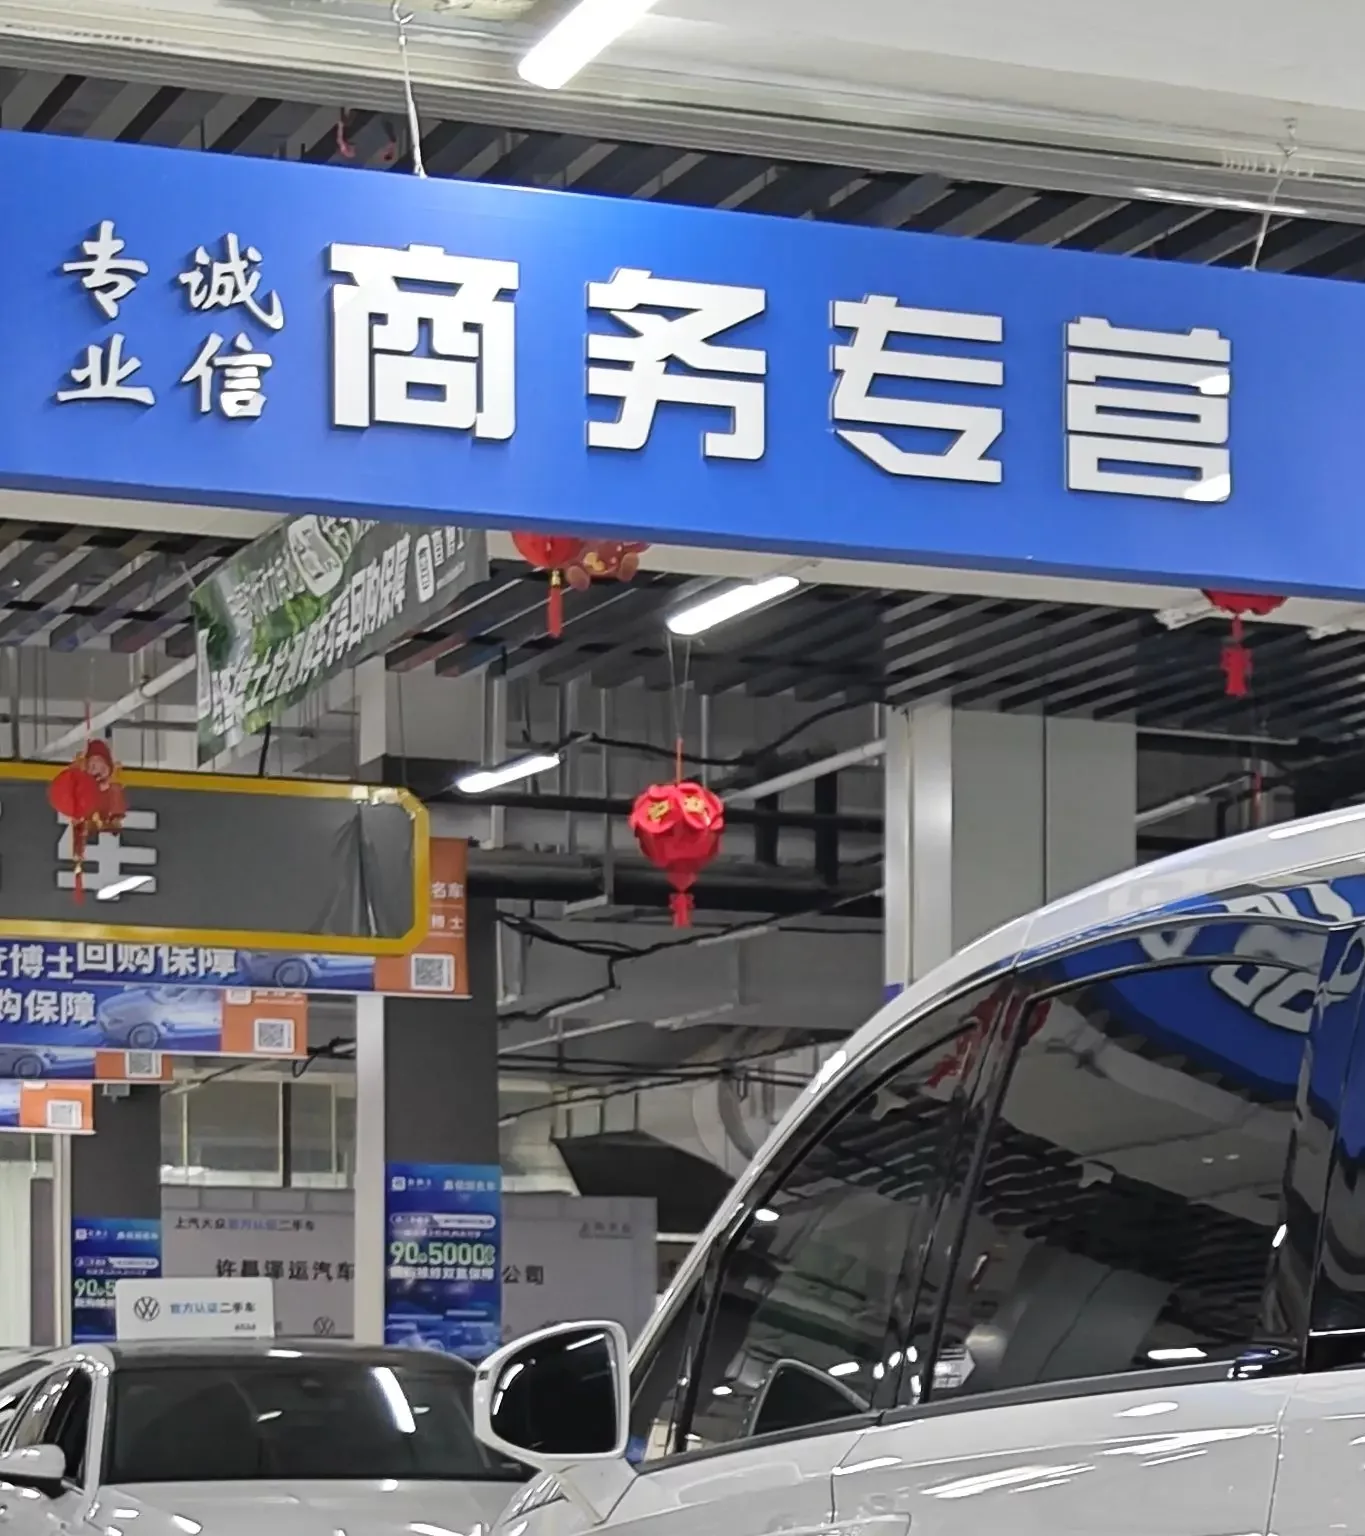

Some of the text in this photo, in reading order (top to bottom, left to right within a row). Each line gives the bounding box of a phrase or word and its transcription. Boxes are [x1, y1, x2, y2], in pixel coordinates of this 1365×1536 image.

[327, 242, 1232, 503] 商务专营
[0, 941, 238, 980] 博士回购保障
